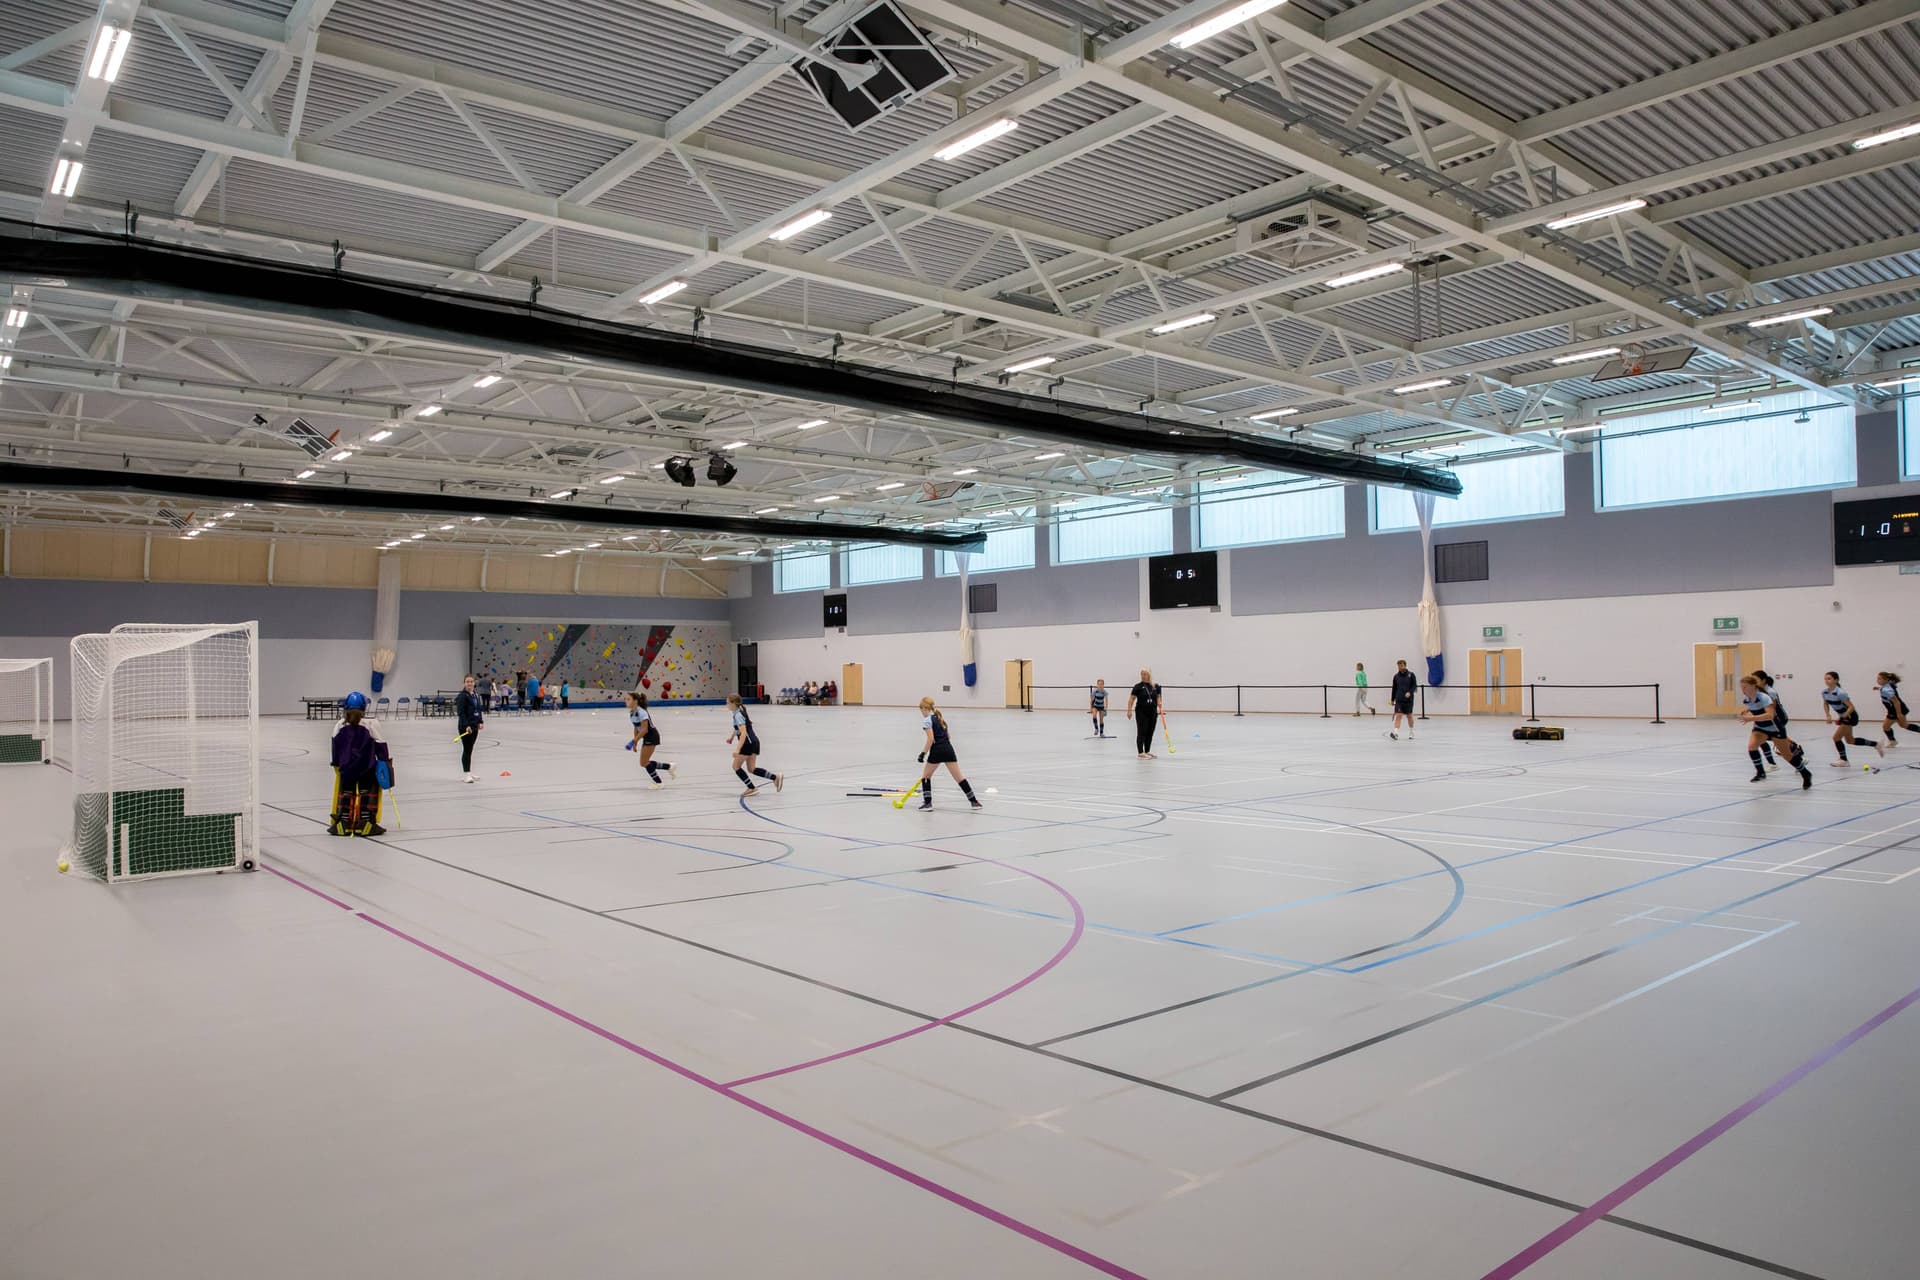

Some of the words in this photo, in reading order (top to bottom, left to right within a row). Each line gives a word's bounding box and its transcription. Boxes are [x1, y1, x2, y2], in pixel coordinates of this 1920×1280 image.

[1881, 522, 1890, 535] 0
[1176, 569, 1182, 579] 0
[1187, 569, 1192, 578] 5
